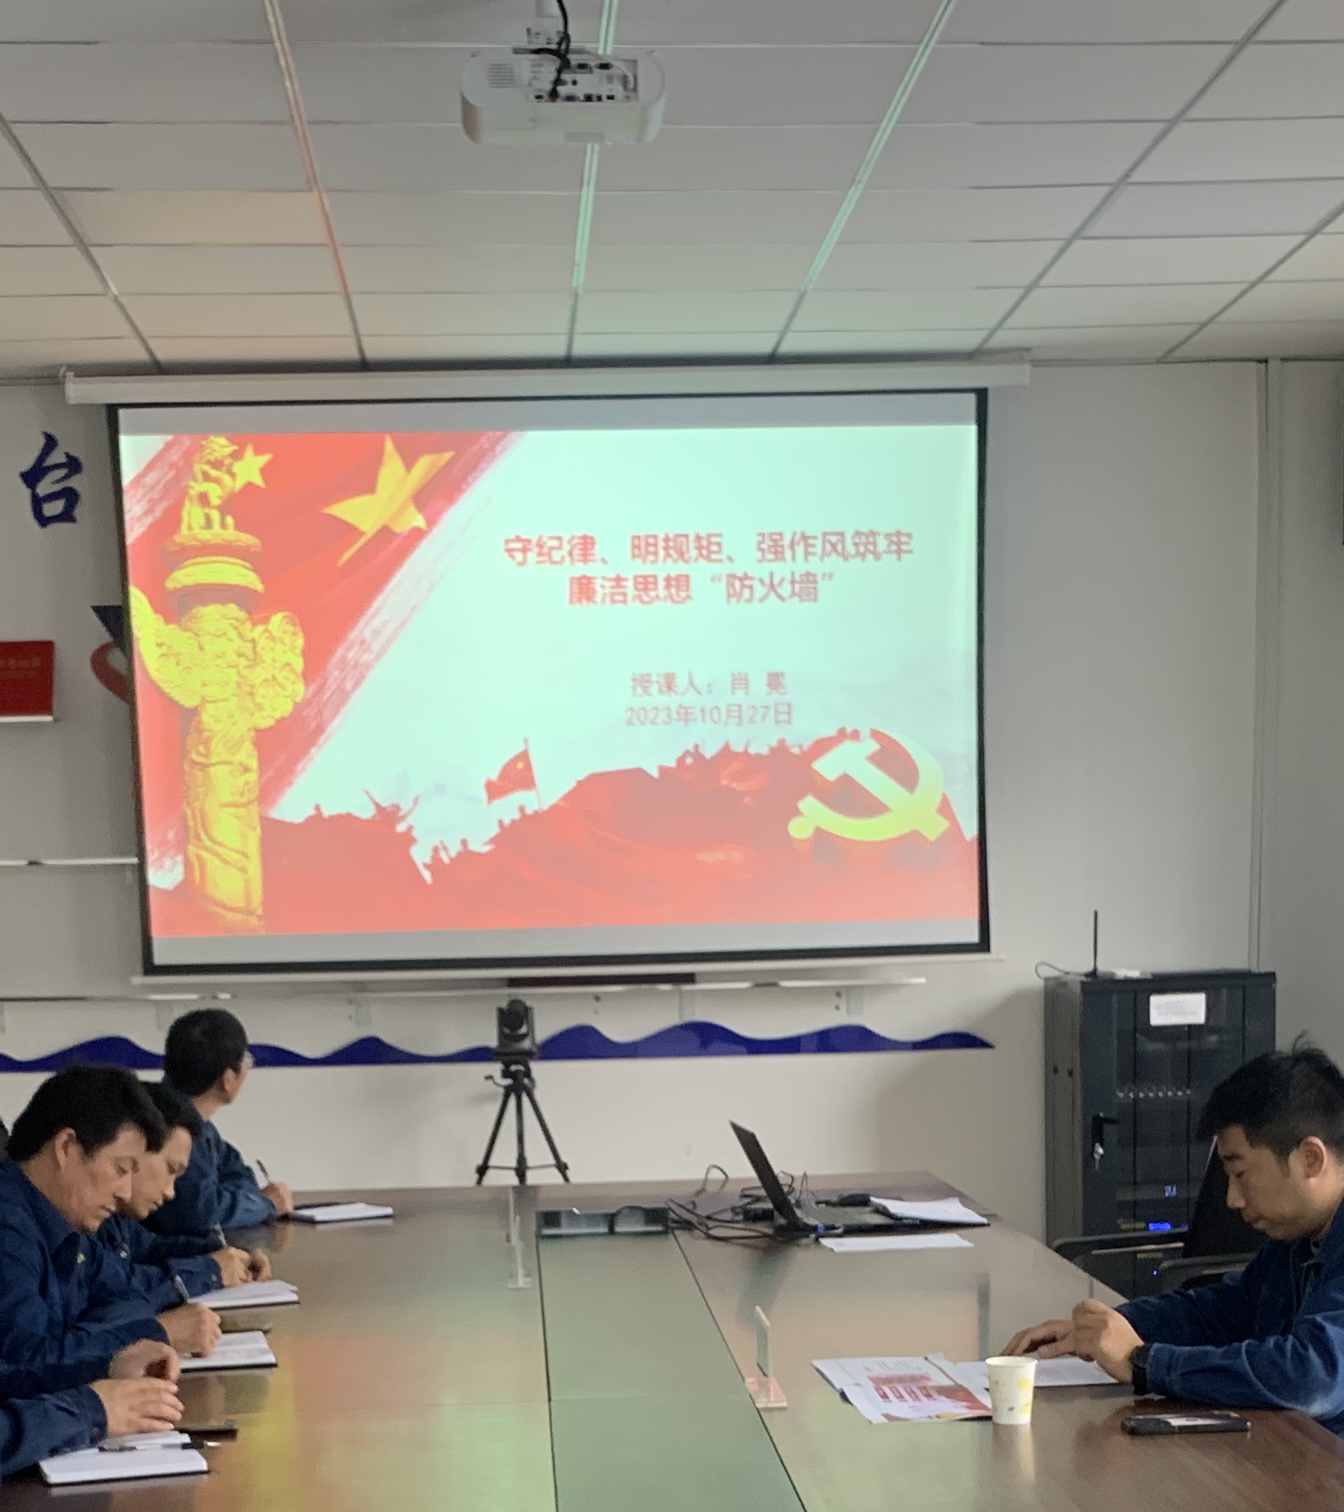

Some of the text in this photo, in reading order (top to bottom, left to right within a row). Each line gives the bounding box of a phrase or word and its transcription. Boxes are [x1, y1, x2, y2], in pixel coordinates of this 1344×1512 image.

[503, 529, 914, 567] 守纪律、明规矩、强作风筑牢
[624, 702, 793, 727] 2023年10月27日
